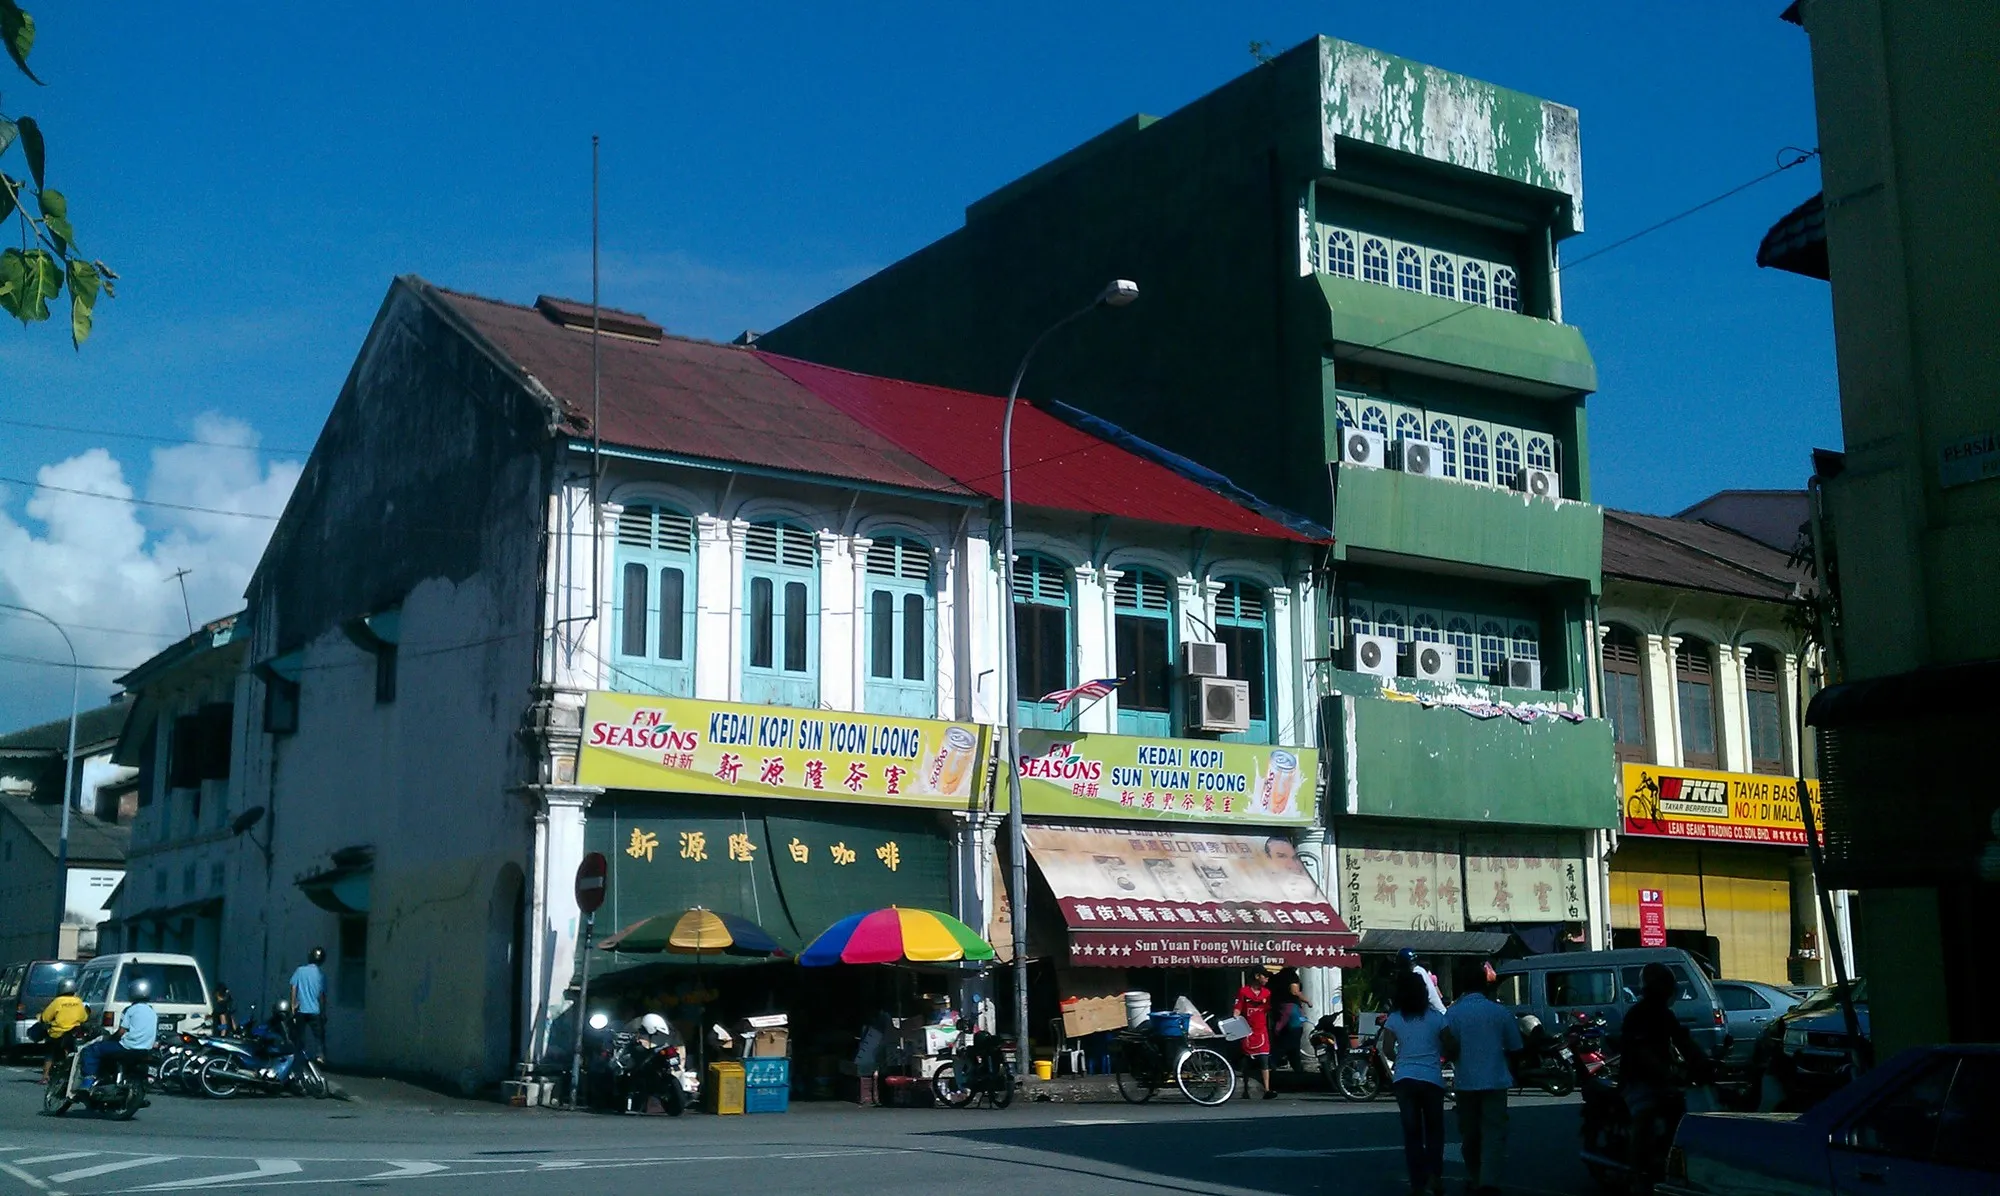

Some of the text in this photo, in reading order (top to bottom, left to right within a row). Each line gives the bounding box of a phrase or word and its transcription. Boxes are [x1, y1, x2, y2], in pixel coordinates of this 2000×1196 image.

[590, 722, 698, 751] SEASONS
[709, 712, 920, 759] KEDAI KOPI SIN YOON LOONG
[662, 753, 694, 770] 时新
[1019, 755, 1101, 780] SEASONS
[1138, 747, 1223, 769] KEDAI KOPI
[714, 753, 907, 795] 新源隆茶室
[1112, 768, 1246, 792] SUN YUAN FOONG
[1073, 782, 1099, 798] 时新
[1679, 779, 1726, 803] FKR
[1734, 781, 1769, 801] TAYAR
[1665, 802, 1724, 814] TAYAR BERPRESTASI
[1734, 802, 1758, 819] NO.1
[1762, 803, 1771, 821] DI
[1668, 822, 1685, 835] LEAN
[1686, 823, 1706, 836] SEANG
[1707, 824, 1733, 838] TRADING
[625, 827, 902, 872] 新源隆白咖啡
[1135, 939, 1303, 954] Sun Yuan Foong White Coffee
[1151, 955, 1169, 965] The
[1170, 955, 1190, 965] Best
[1192, 955, 1218, 965] White
[1220, 956, 1250, 965] Coffee
[1261, 956, 1285, 965] Town
